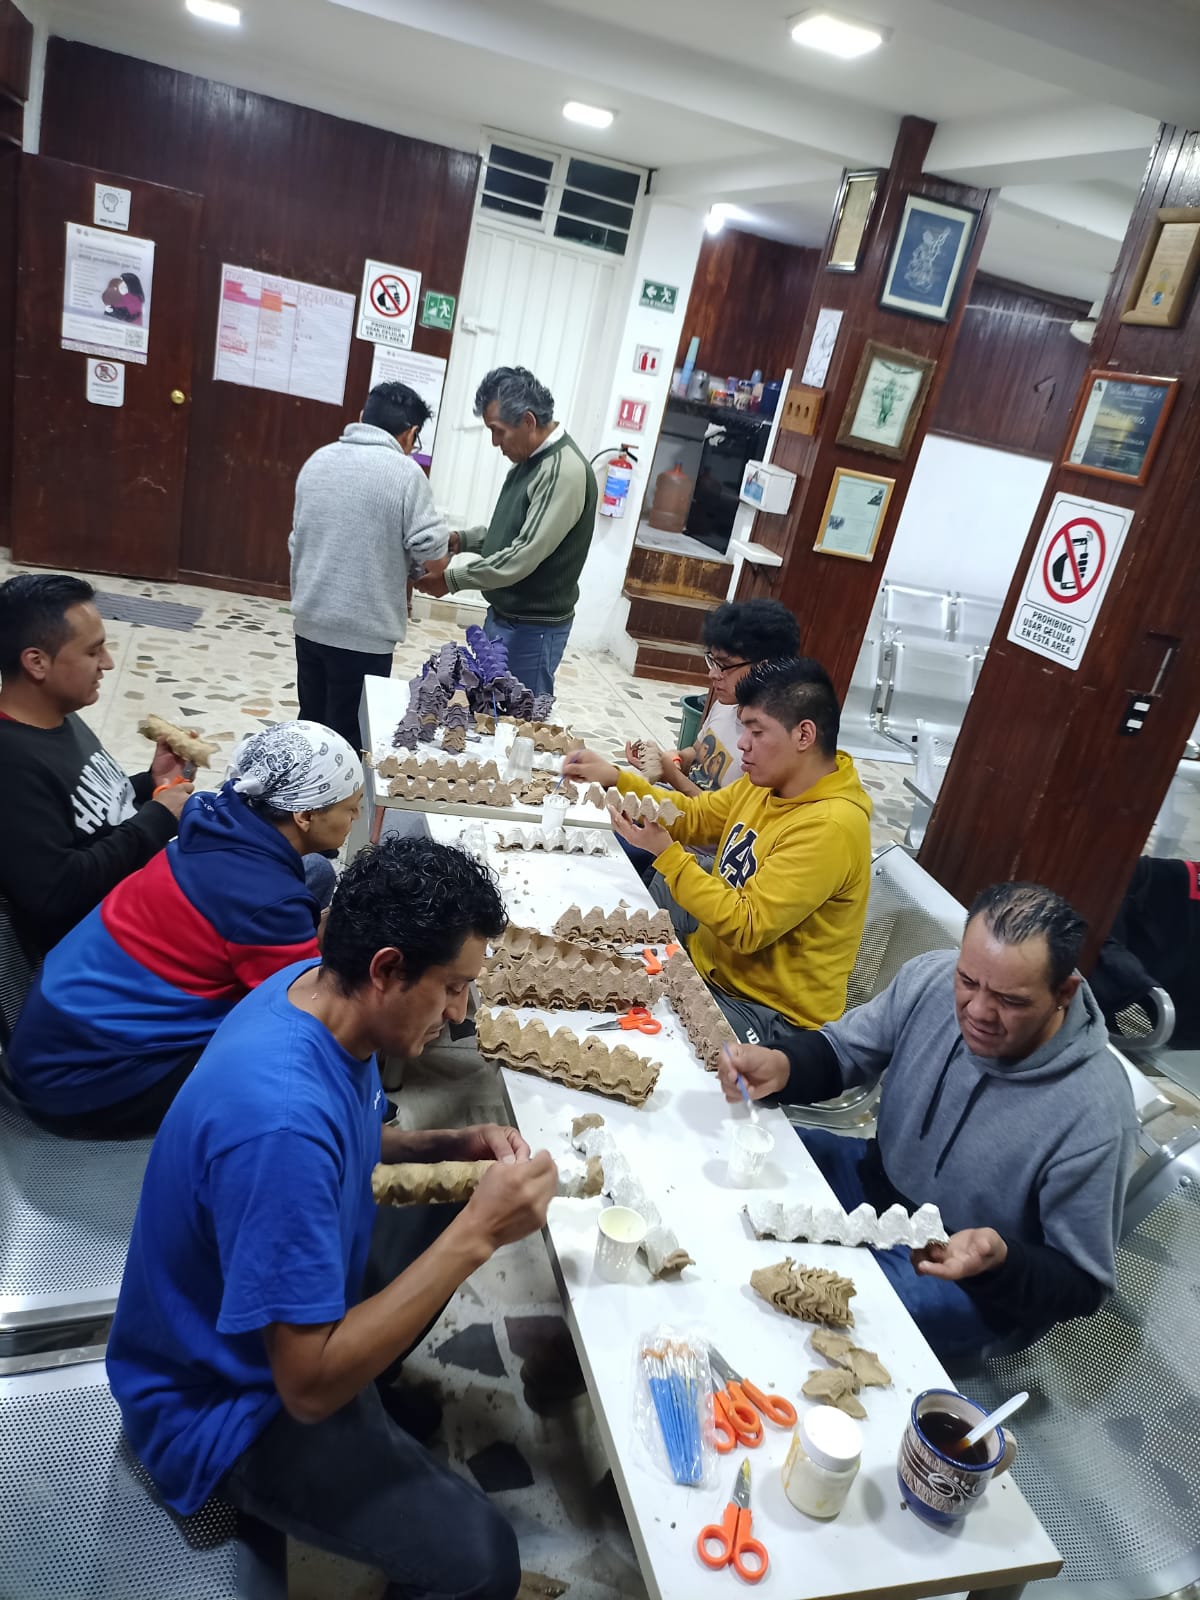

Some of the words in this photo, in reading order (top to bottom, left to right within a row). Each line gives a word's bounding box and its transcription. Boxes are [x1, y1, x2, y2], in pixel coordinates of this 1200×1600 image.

[1023, 618, 1042, 632] USAR
[1043, 626, 1076, 646] CELULAR
[1032, 611, 1072, 633] PROHIBIDO
[1021, 627, 1032, 638] EN
[1032, 632, 1049, 645] ESTA
[1050, 641, 1070, 654] AREA
